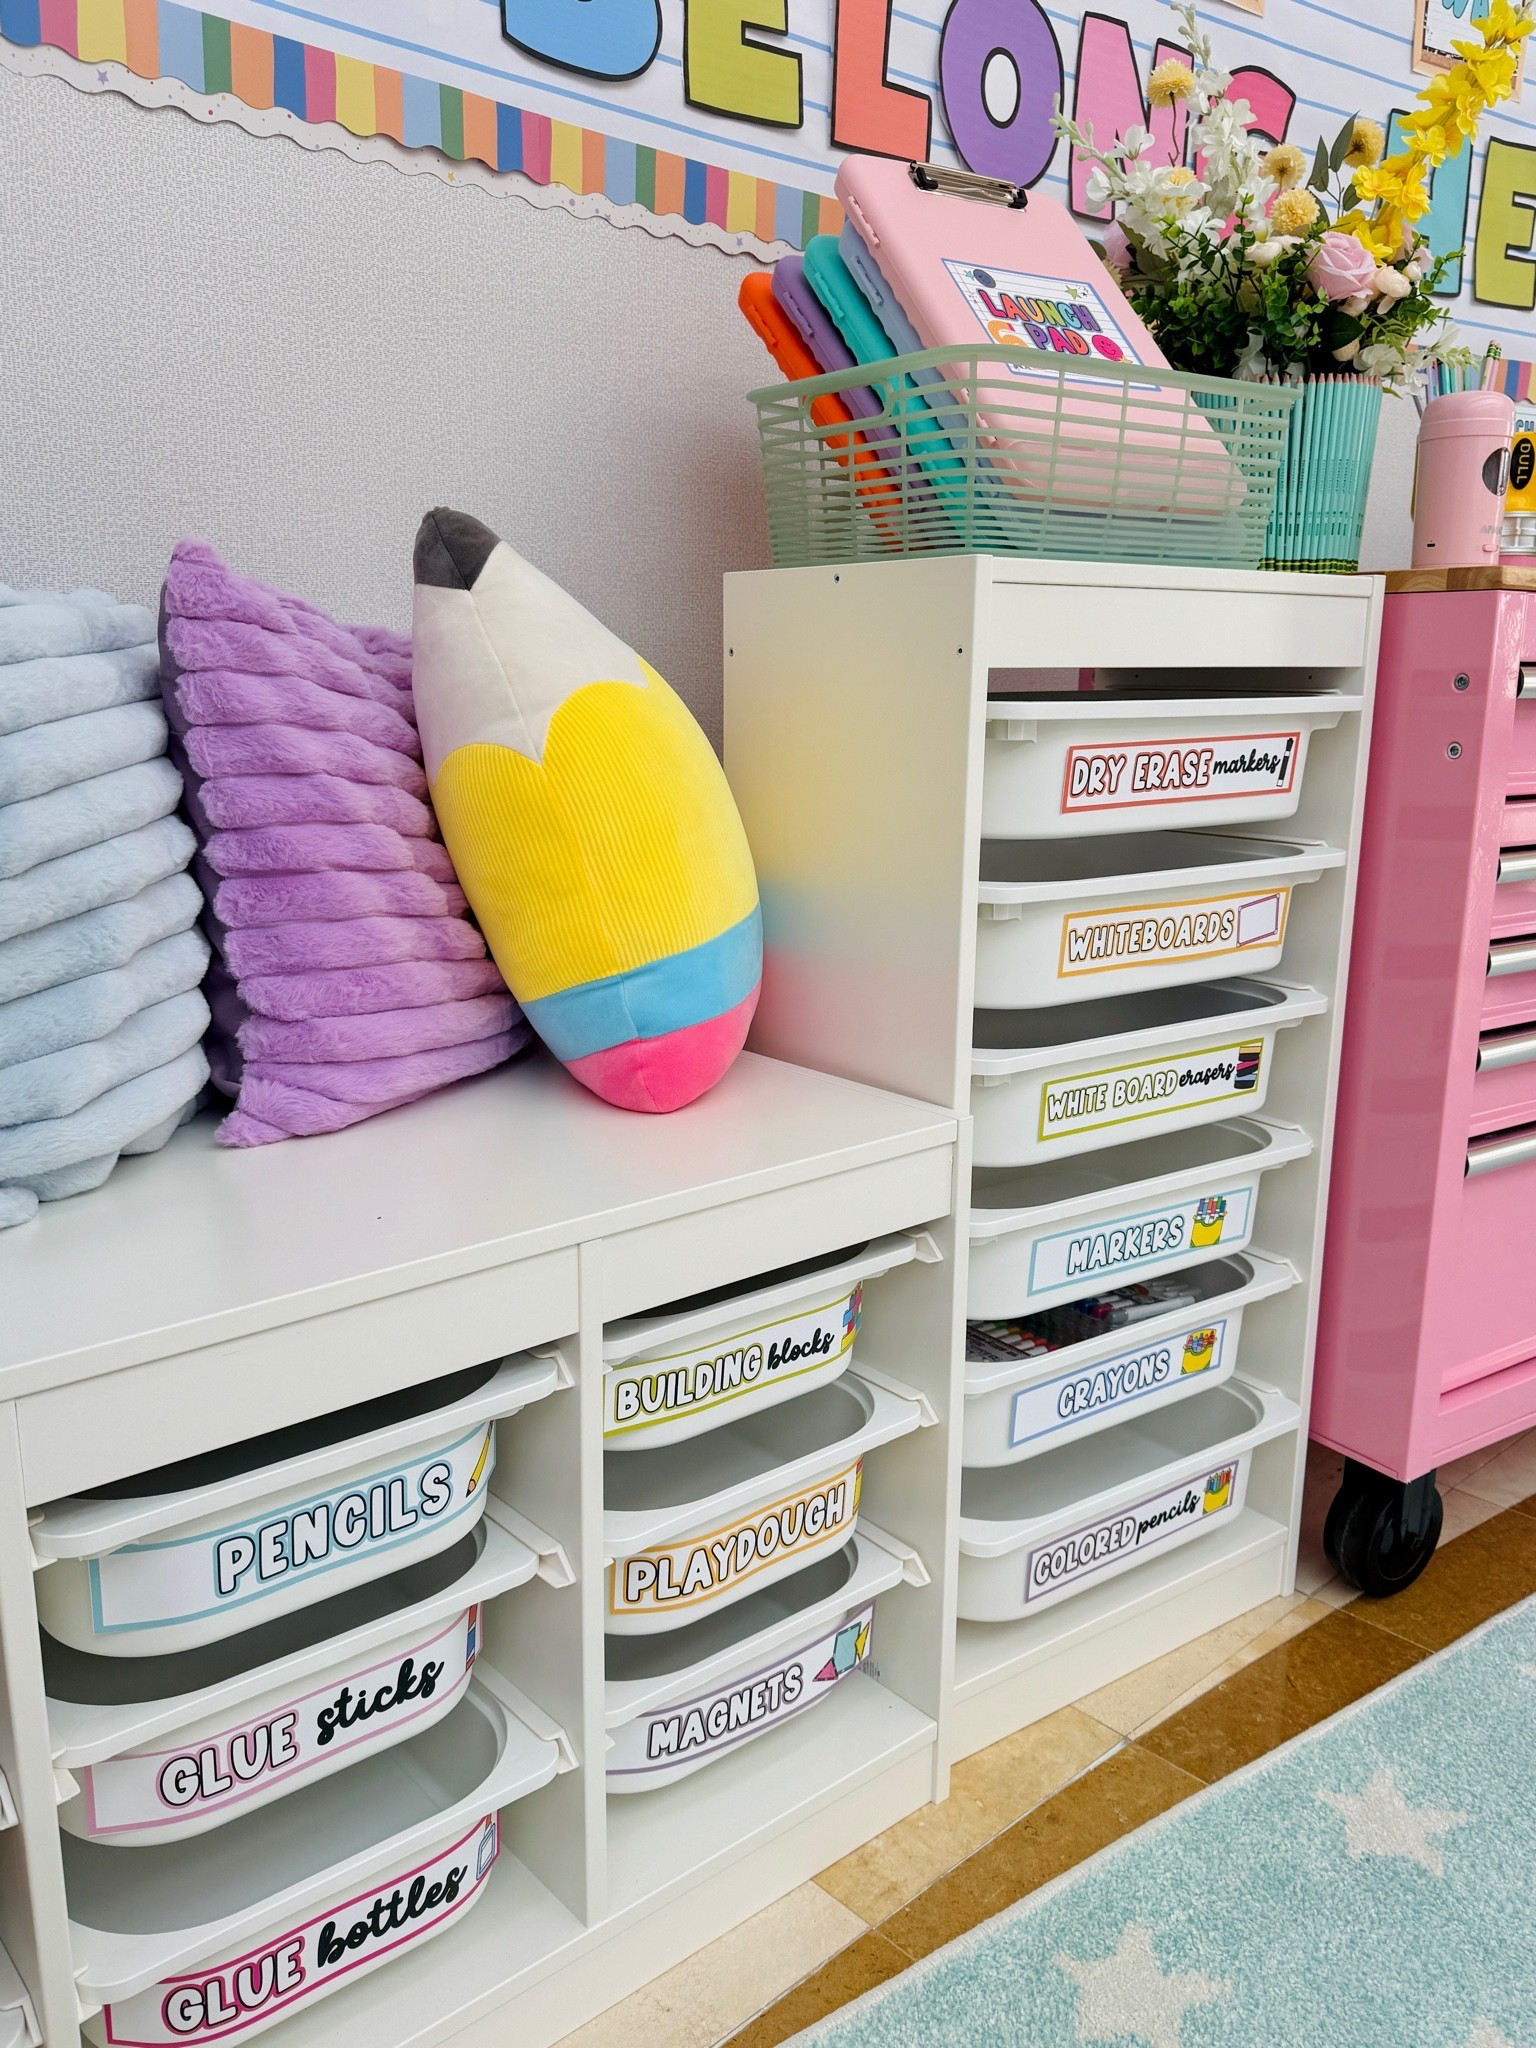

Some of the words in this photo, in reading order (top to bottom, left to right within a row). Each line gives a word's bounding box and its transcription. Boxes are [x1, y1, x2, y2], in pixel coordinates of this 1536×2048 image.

[977, 289, 1103, 333] LAUNCH
[1022, 321, 1091, 356] PAD
[1516, 443, 1531, 484] DULL
[1070, 755, 1127, 797] DRY
[1131, 749, 1213, 793] ERASE
[1213, 749, 1280, 775] markers
[1067, 909, 1234, 962] WHITEBOARDS
[1048, 1083, 1108, 1122] WHITE
[1112, 1069, 1178, 1109] BOARD
[1179, 1062, 1235, 1088] erasers
[1067, 1215, 1184, 1276] MARKERS
[615, 1344, 763, 1422] BUILDING
[767, 1328, 834, 1371] blocks
[1057, 1349, 1170, 1419] CRAYONS
[216, 1461, 452, 1596] PENCILS
[625, 1482, 847, 1603] PLAYDOUGH
[1034, 1517, 1136, 1586] COLORED
[1136, 1490, 1200, 1545] pencils
[158, 1710, 298, 1808] GLUE
[317, 1658, 444, 1746] sticks
[648, 1663, 803, 1759] MAGNETS
[163, 1936, 305, 2035] GLUE
[317, 1865, 468, 1968] bottles
